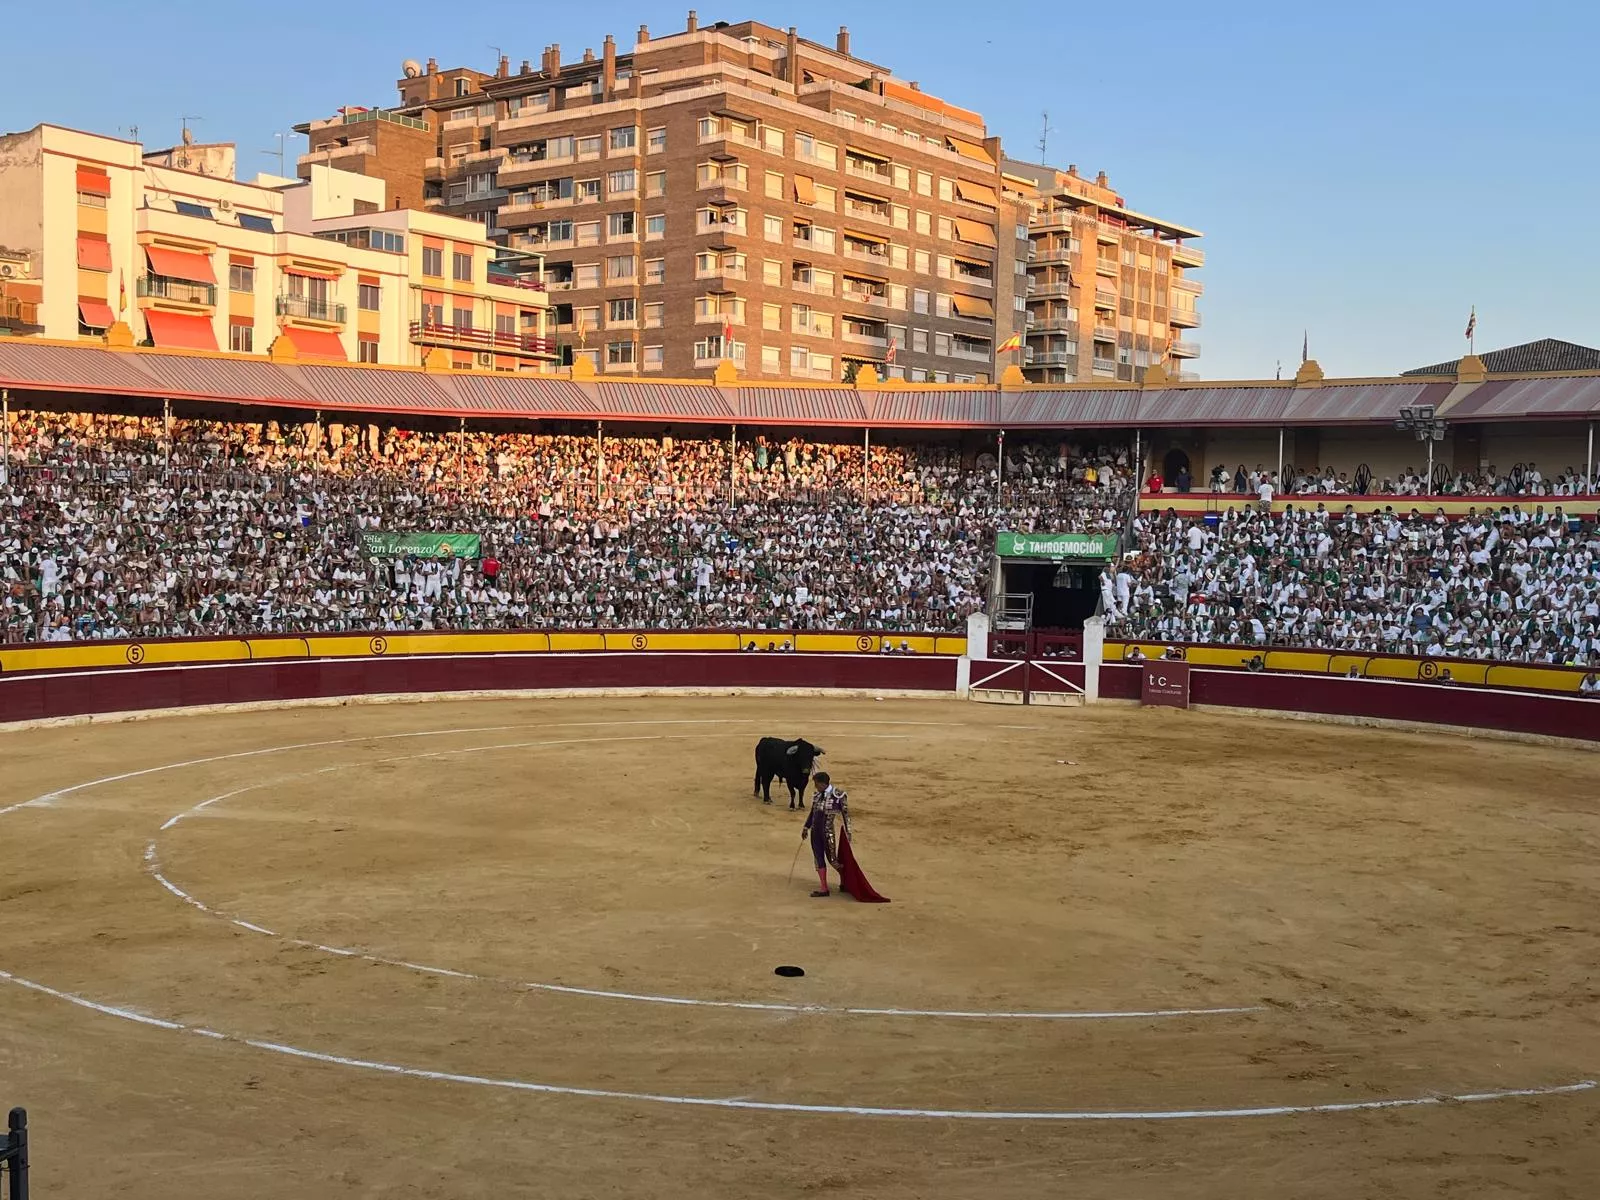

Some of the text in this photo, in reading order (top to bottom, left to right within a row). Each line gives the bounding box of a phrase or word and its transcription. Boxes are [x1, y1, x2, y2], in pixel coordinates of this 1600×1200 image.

[1029, 540, 1103, 554] TAUROEMOCIÓN
[375, 639, 382, 651] 5
[636, 637, 643, 648] 5
[861, 638, 868, 648] 5
[132, 648, 139, 660] 5
[1424, 664, 1432, 676] 6
